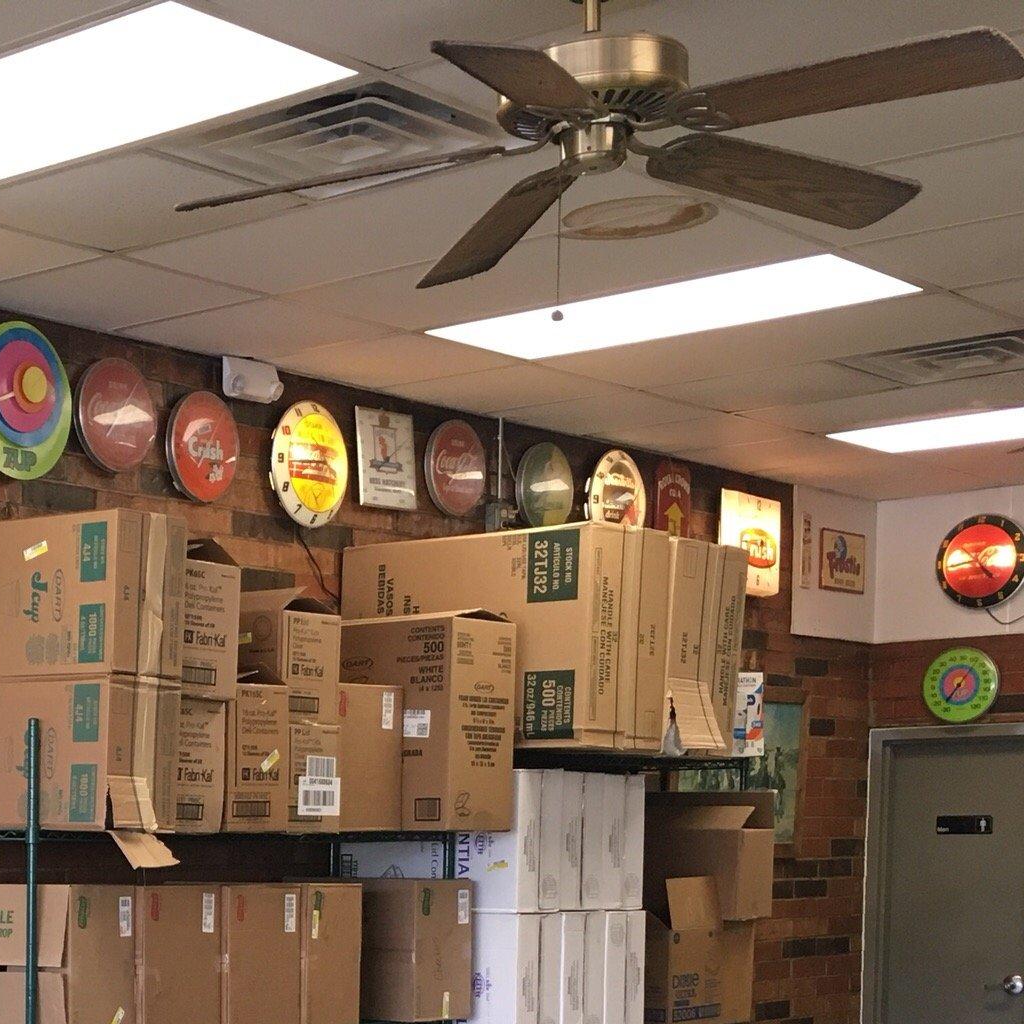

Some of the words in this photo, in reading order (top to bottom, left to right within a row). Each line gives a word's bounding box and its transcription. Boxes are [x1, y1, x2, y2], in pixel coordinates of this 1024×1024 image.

[277, 453, 284, 463] 9
[282, 482, 289, 492] 8
[533, 540, 549, 594] 32TJ32
[377, 564, 386, 615] BEBIDAS
[386, 578, 394, 616] VASOS
[606, 590, 614, 628] HANDLE
[411, 625, 445, 634] CONTENTS
[599, 630, 607, 653] CON
[423, 642, 444, 654] 500
[410, 675, 443, 684] BLANCO
[418, 665, 444, 675] WHITE
[527, 674, 536, 687] 32
[598, 655, 606, 695] CUIDADO
[542, 680, 555, 707] 500
[555, 685, 564, 726] CONTENIDO
[563, 686, 572, 723] CONTENTS
